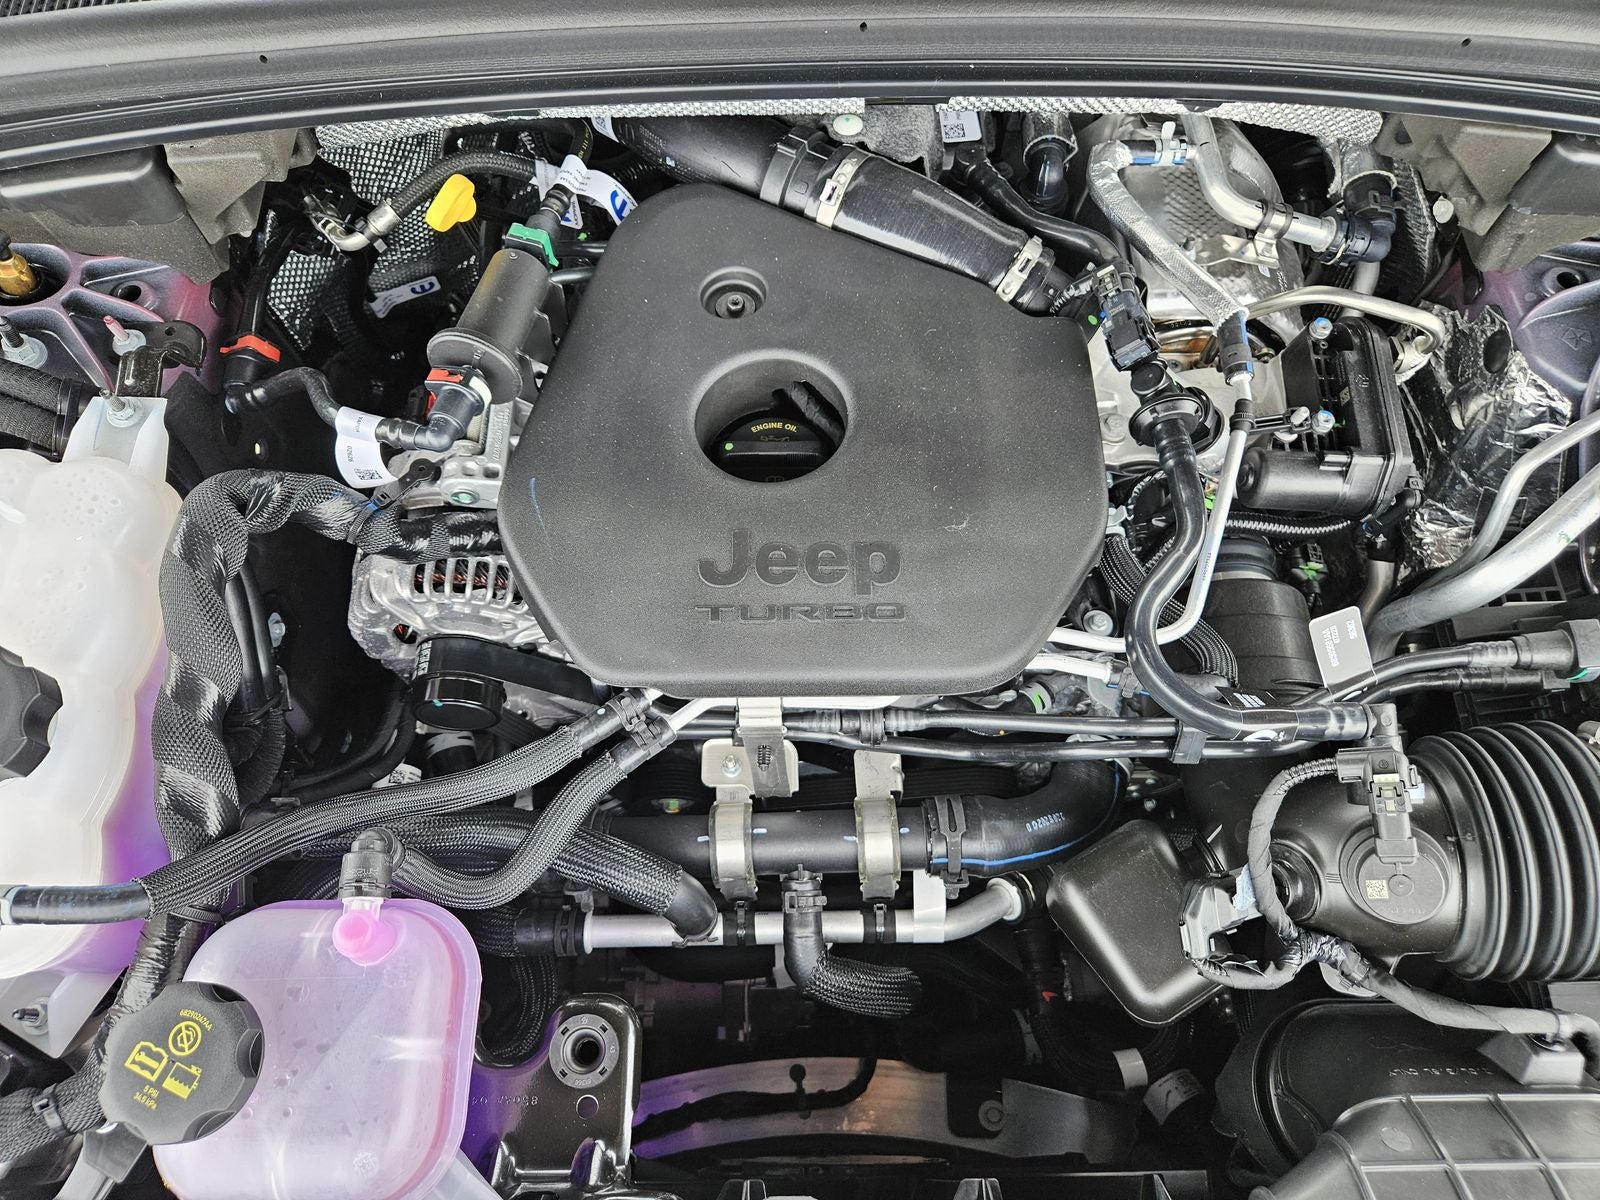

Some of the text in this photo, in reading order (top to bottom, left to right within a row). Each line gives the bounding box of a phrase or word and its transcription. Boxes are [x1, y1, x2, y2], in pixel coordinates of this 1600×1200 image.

[750, 421, 798, 433] ENGINE OIL
[698, 528, 901, 596] Jeep
[695, 603, 905, 623] TURBO
[148, 1086, 160, 1098] PSI
